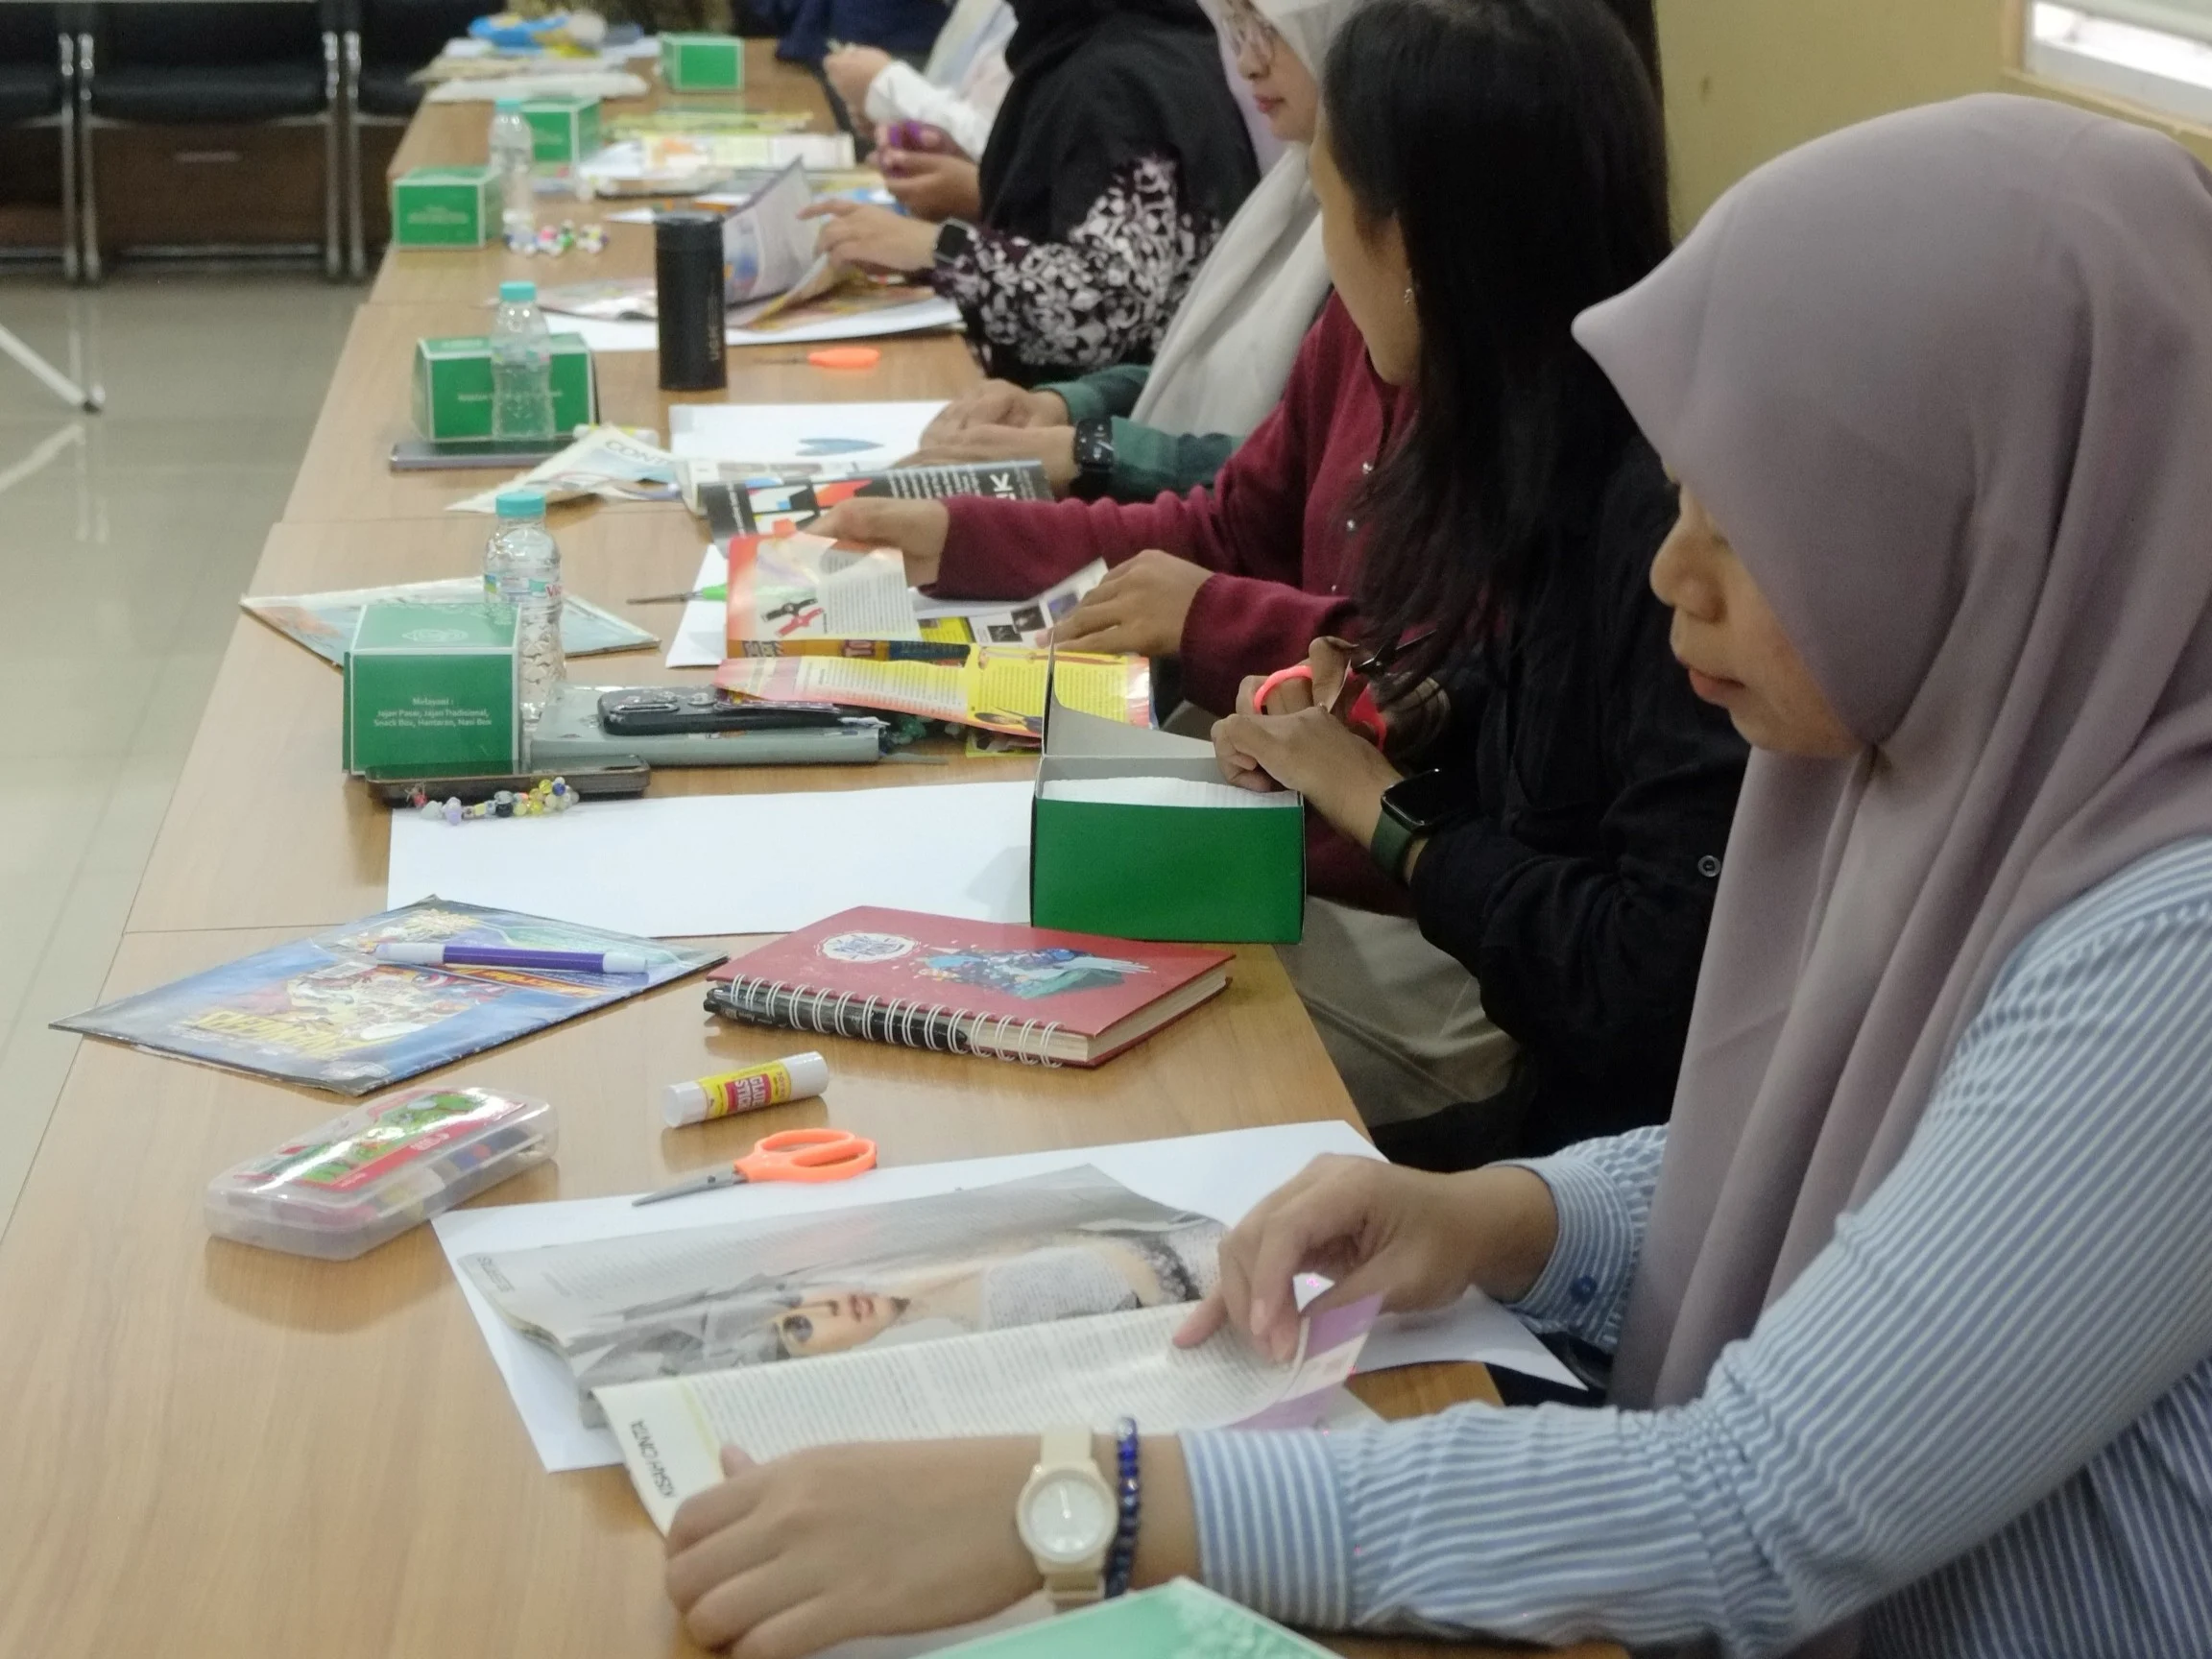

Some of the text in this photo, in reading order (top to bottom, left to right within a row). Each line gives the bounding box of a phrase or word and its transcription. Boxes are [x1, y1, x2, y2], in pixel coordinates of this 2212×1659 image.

[752, 1076, 766, 1106] GLUE
[629, 1420, 677, 1499] KISAH CINTA
